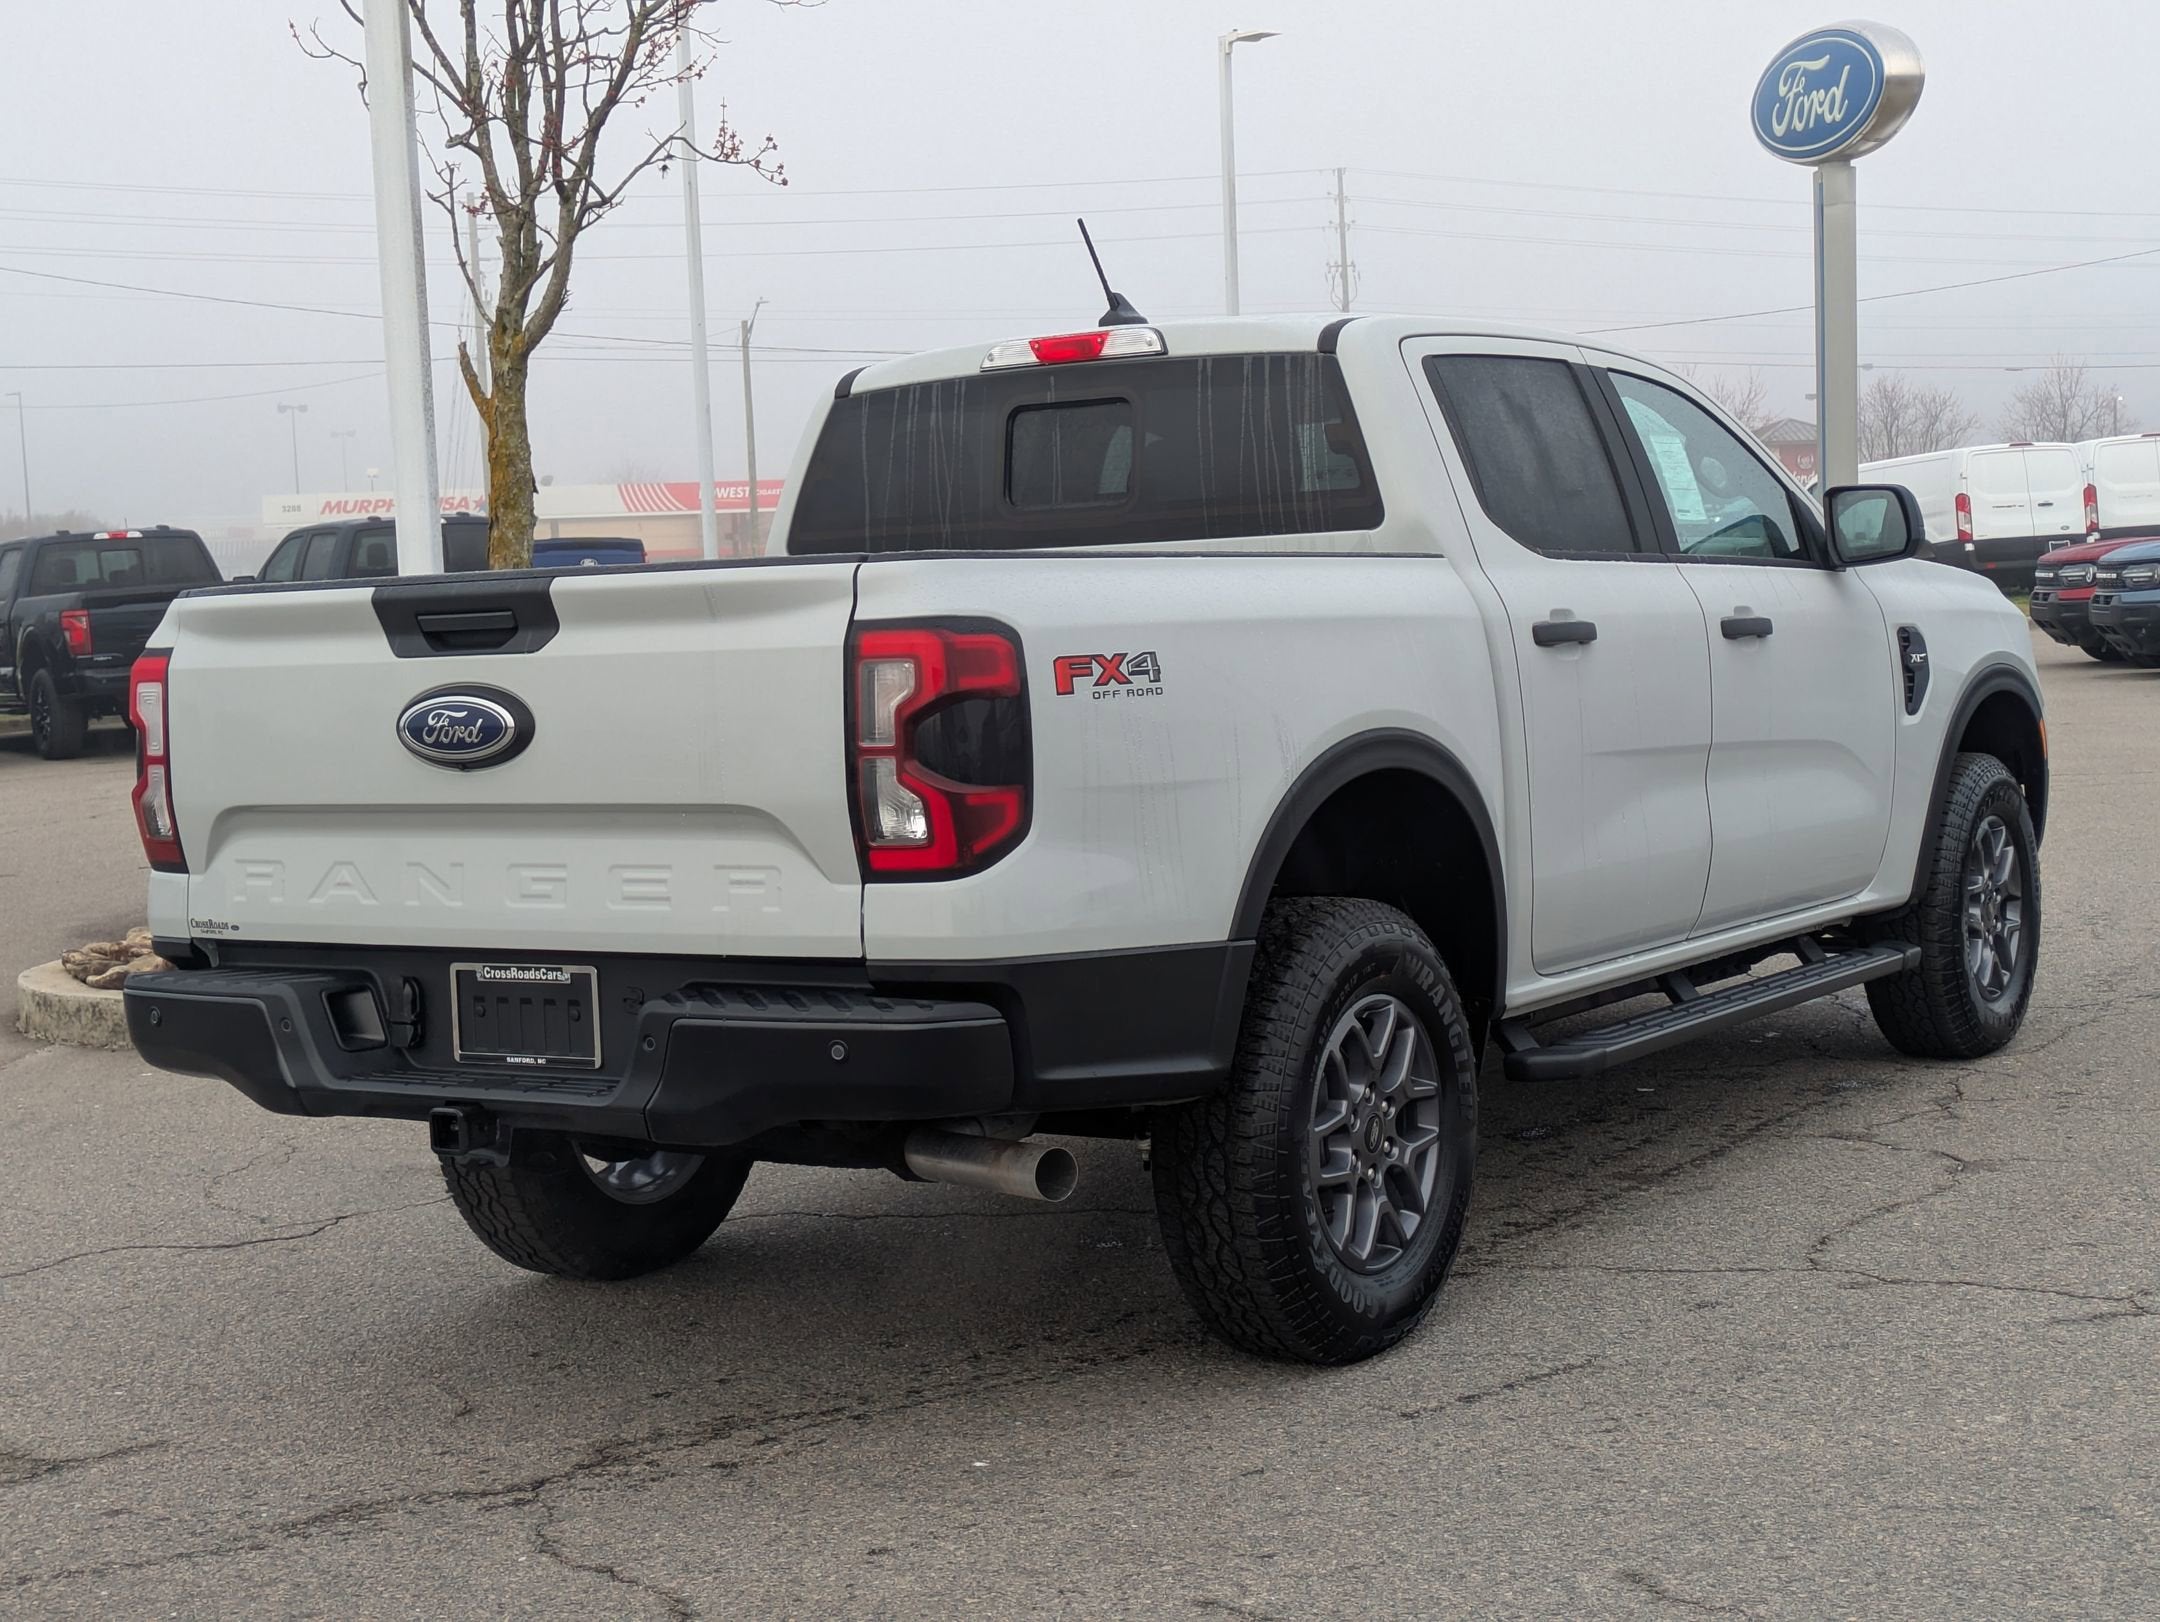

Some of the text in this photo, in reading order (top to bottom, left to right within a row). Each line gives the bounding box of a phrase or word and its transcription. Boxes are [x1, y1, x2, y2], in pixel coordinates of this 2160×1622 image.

[1772, 54, 1851, 137] Ford
[1053, 651, 1162, 696] FX4
[1092, 686, 1164, 700] OFF ROAD
[422, 709, 483, 744] Ford
[231, 857, 784, 913] RANGER
[483, 966, 562, 981] CrossRoadsCars
[1404, 950, 1475, 1121] WRANGLER
